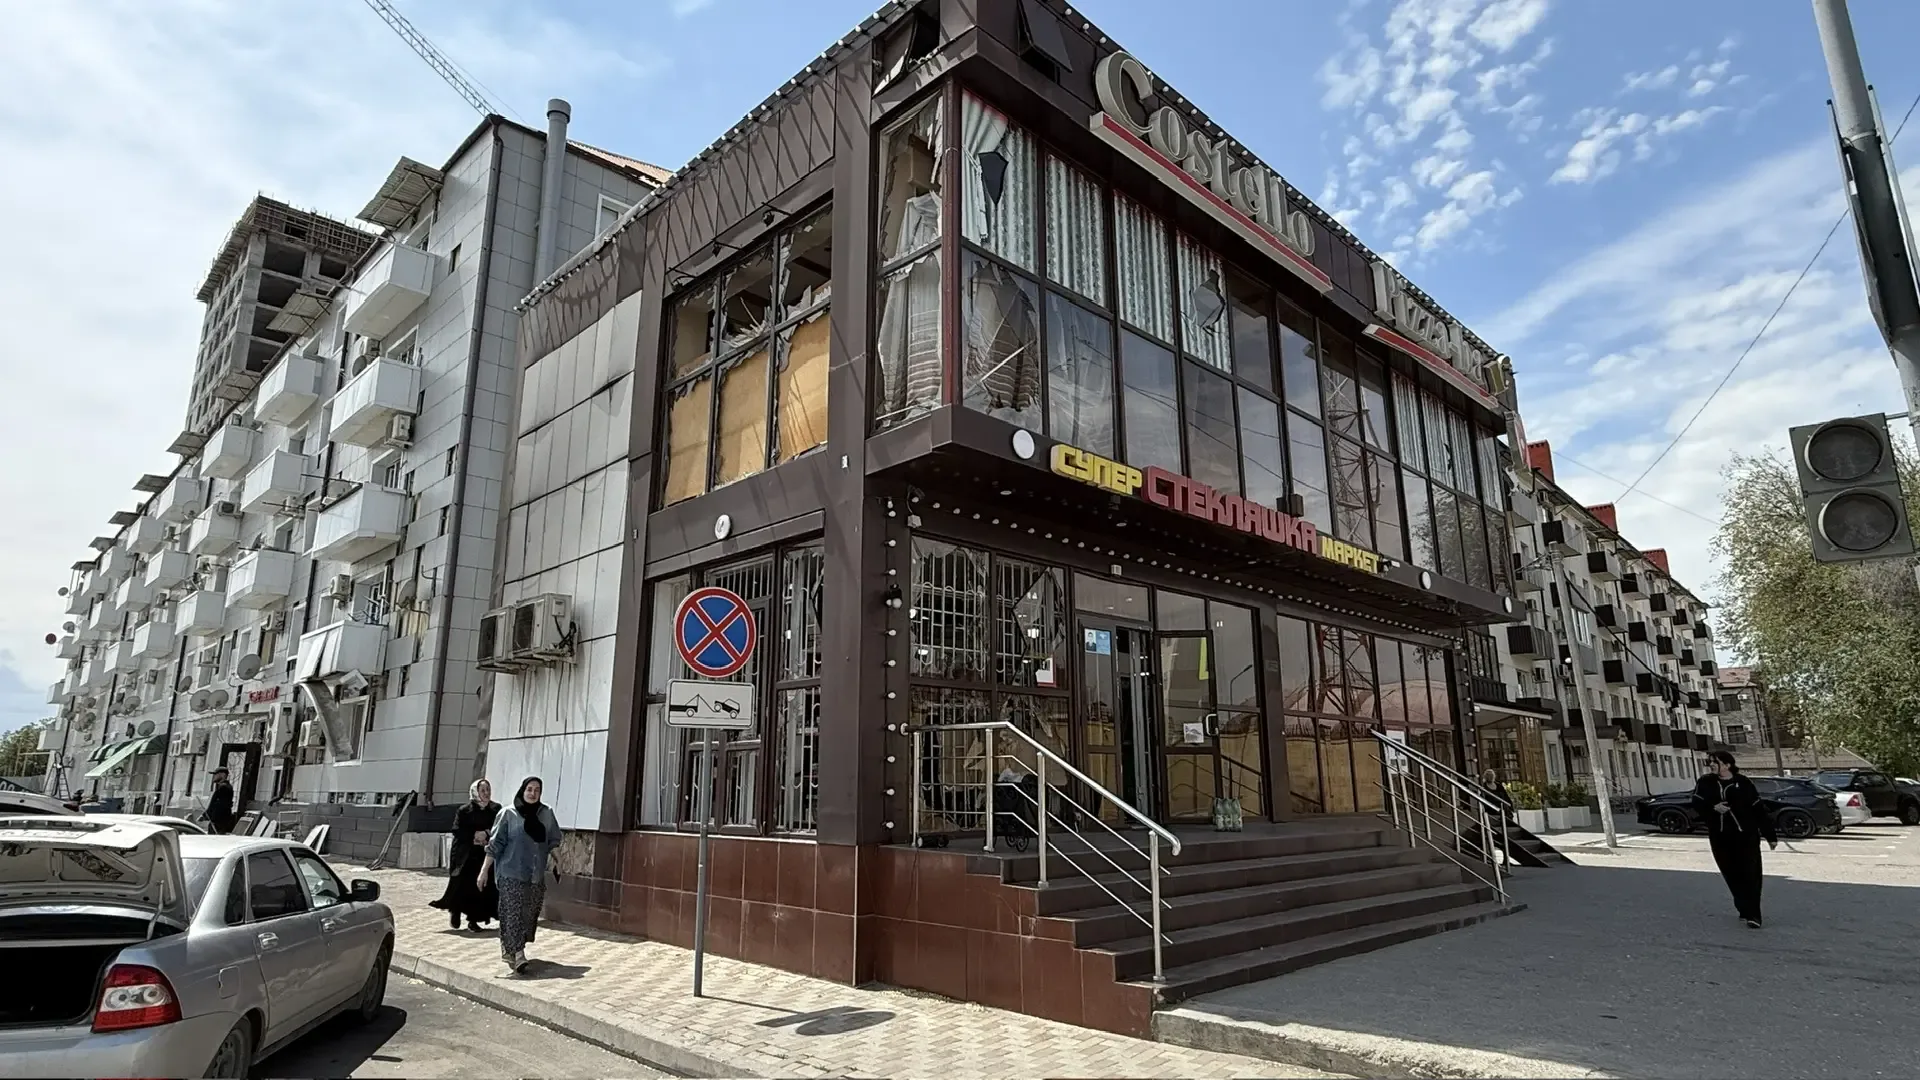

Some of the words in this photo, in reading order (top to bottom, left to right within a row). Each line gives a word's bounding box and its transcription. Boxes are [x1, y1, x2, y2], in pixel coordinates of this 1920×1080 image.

[1095, 51, 1315, 257] Costello
[1051, 444, 1142, 495] СУПЕР
[1142, 465, 1318, 554] СТЕКЛЯШКА
[1319, 535, 1381, 575] МАРКЕТ
